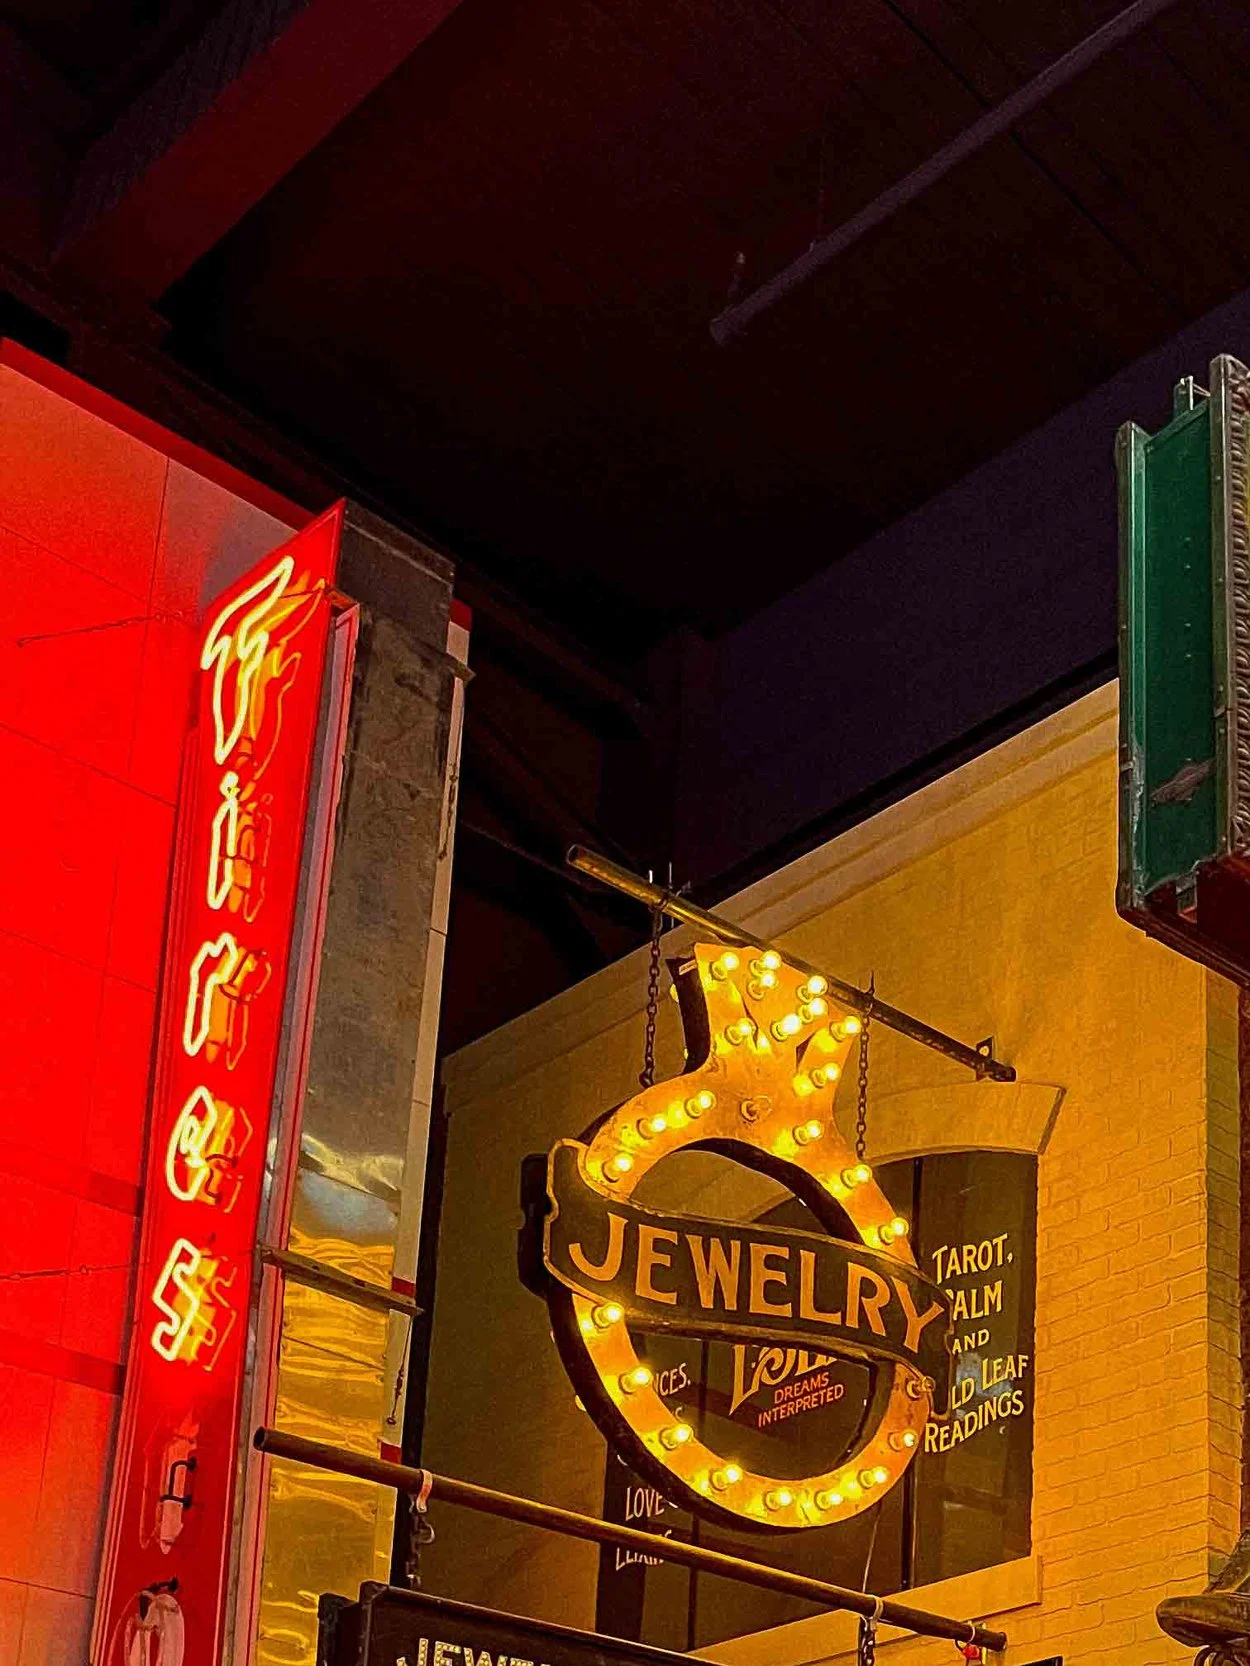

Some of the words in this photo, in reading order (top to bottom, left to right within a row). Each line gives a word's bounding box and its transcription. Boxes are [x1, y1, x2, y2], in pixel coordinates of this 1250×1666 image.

[932, 1233, 1012, 1285] TAROT,
[568, 1212, 945, 1353] JEWELRY
[946, 1280, 1002, 1321] ALM
[952, 1329, 990, 1355] AND
[774, 1372, 829, 1404] DREAMS
[982, 1355, 1028, 1391] LEAF
[758, 1384, 845, 1427] INTERPRETED
[924, 1390, 1024, 1453] READINGS
